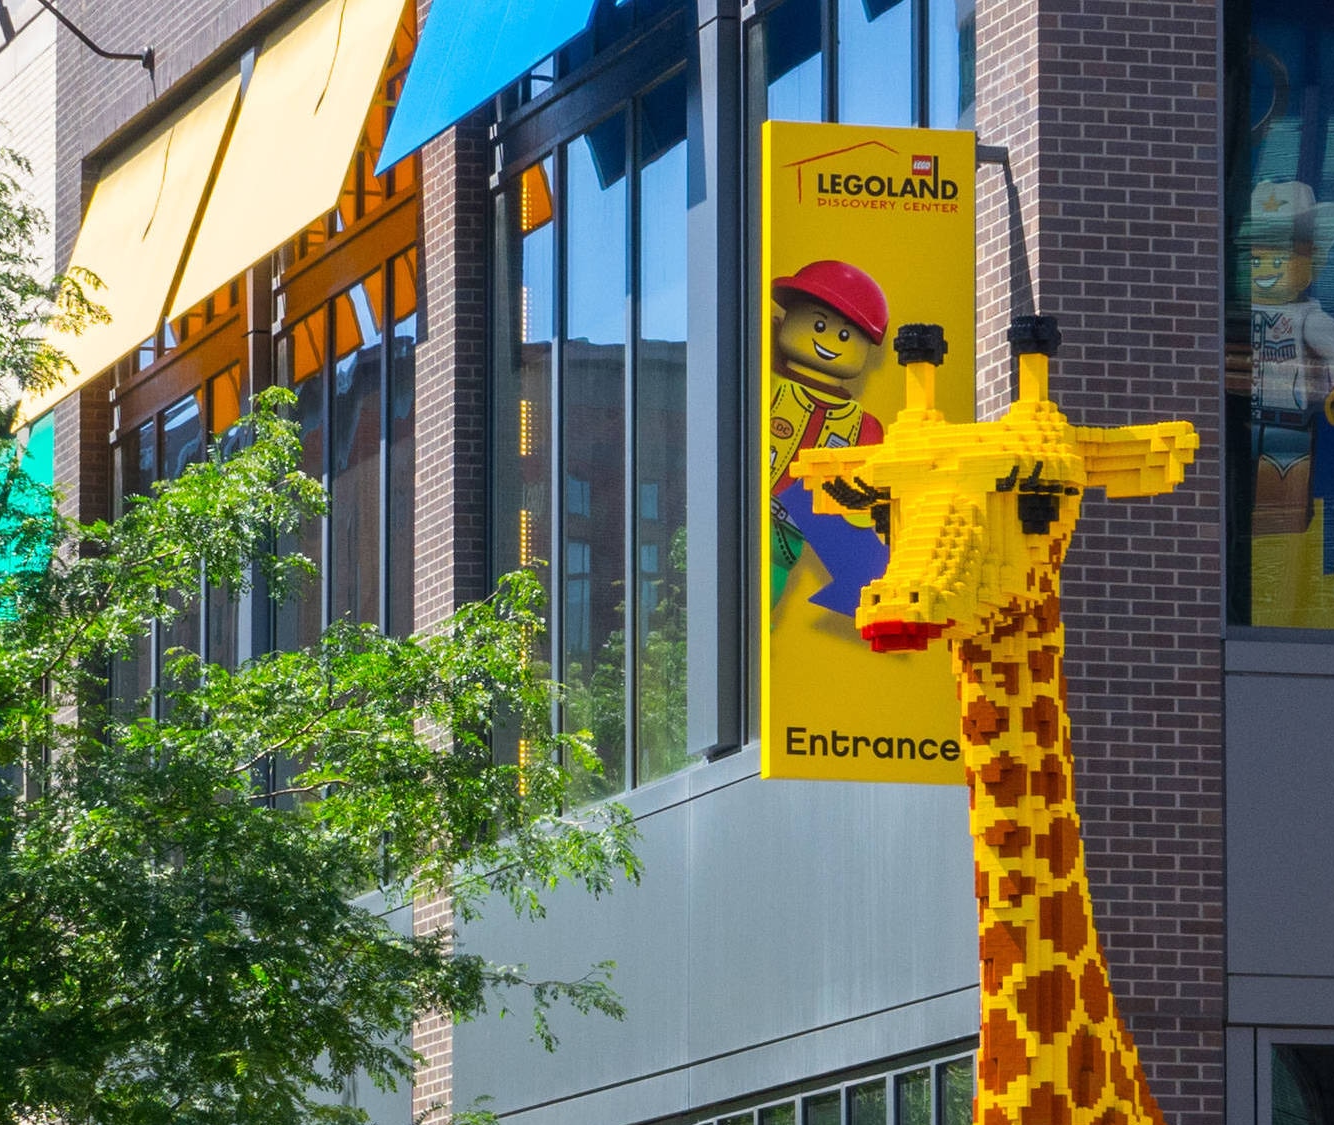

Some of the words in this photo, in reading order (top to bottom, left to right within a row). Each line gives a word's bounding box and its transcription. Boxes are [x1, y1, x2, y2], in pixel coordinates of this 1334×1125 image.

[818, 156, 958, 200] LEGOLAND
[818, 198, 895, 210] DISCOVERY
[904, 202, 958, 213] CENTER
[786, 727, 961, 762] Entrance
